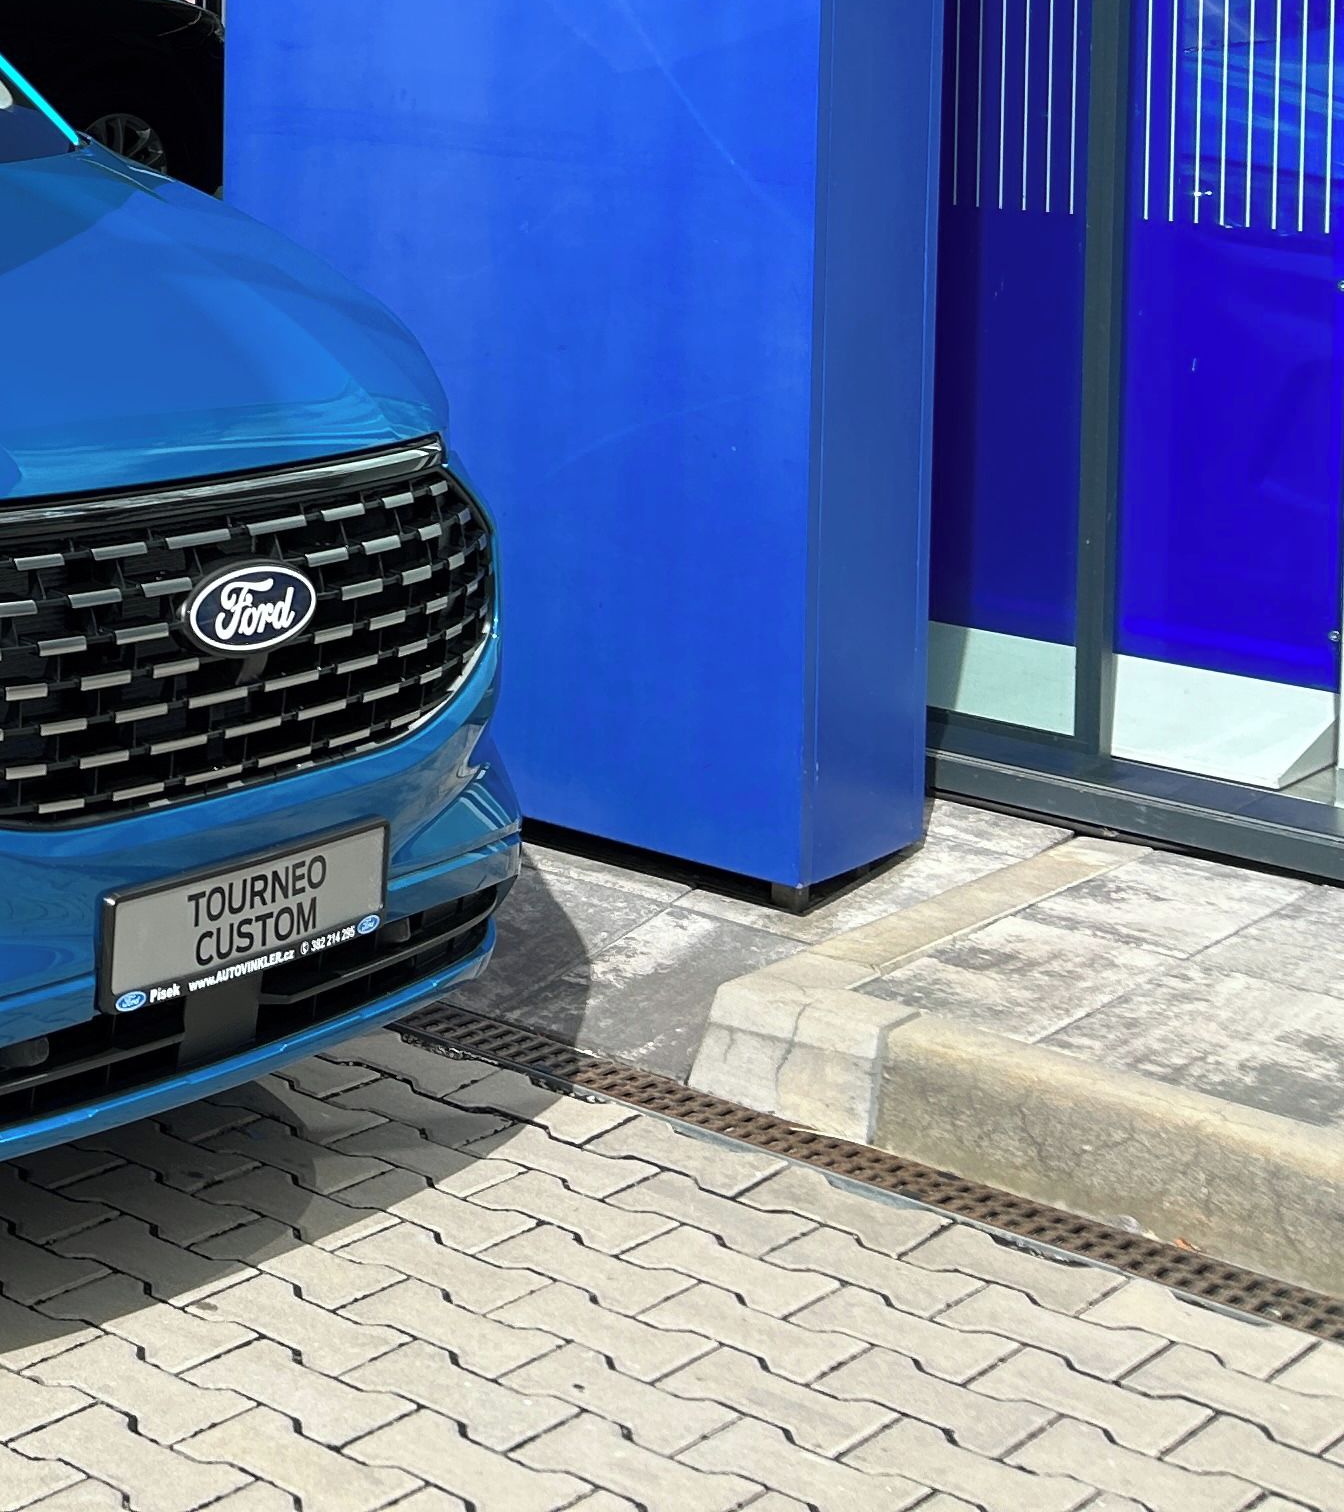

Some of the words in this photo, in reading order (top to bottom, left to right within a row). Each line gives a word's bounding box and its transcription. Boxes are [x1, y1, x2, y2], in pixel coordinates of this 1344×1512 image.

[215, 578, 296, 640] Ford
[187, 854, 327, 928] TOURNEO
[195, 896, 318, 966] CUSTOM
[326, 931, 340, 947] 214
